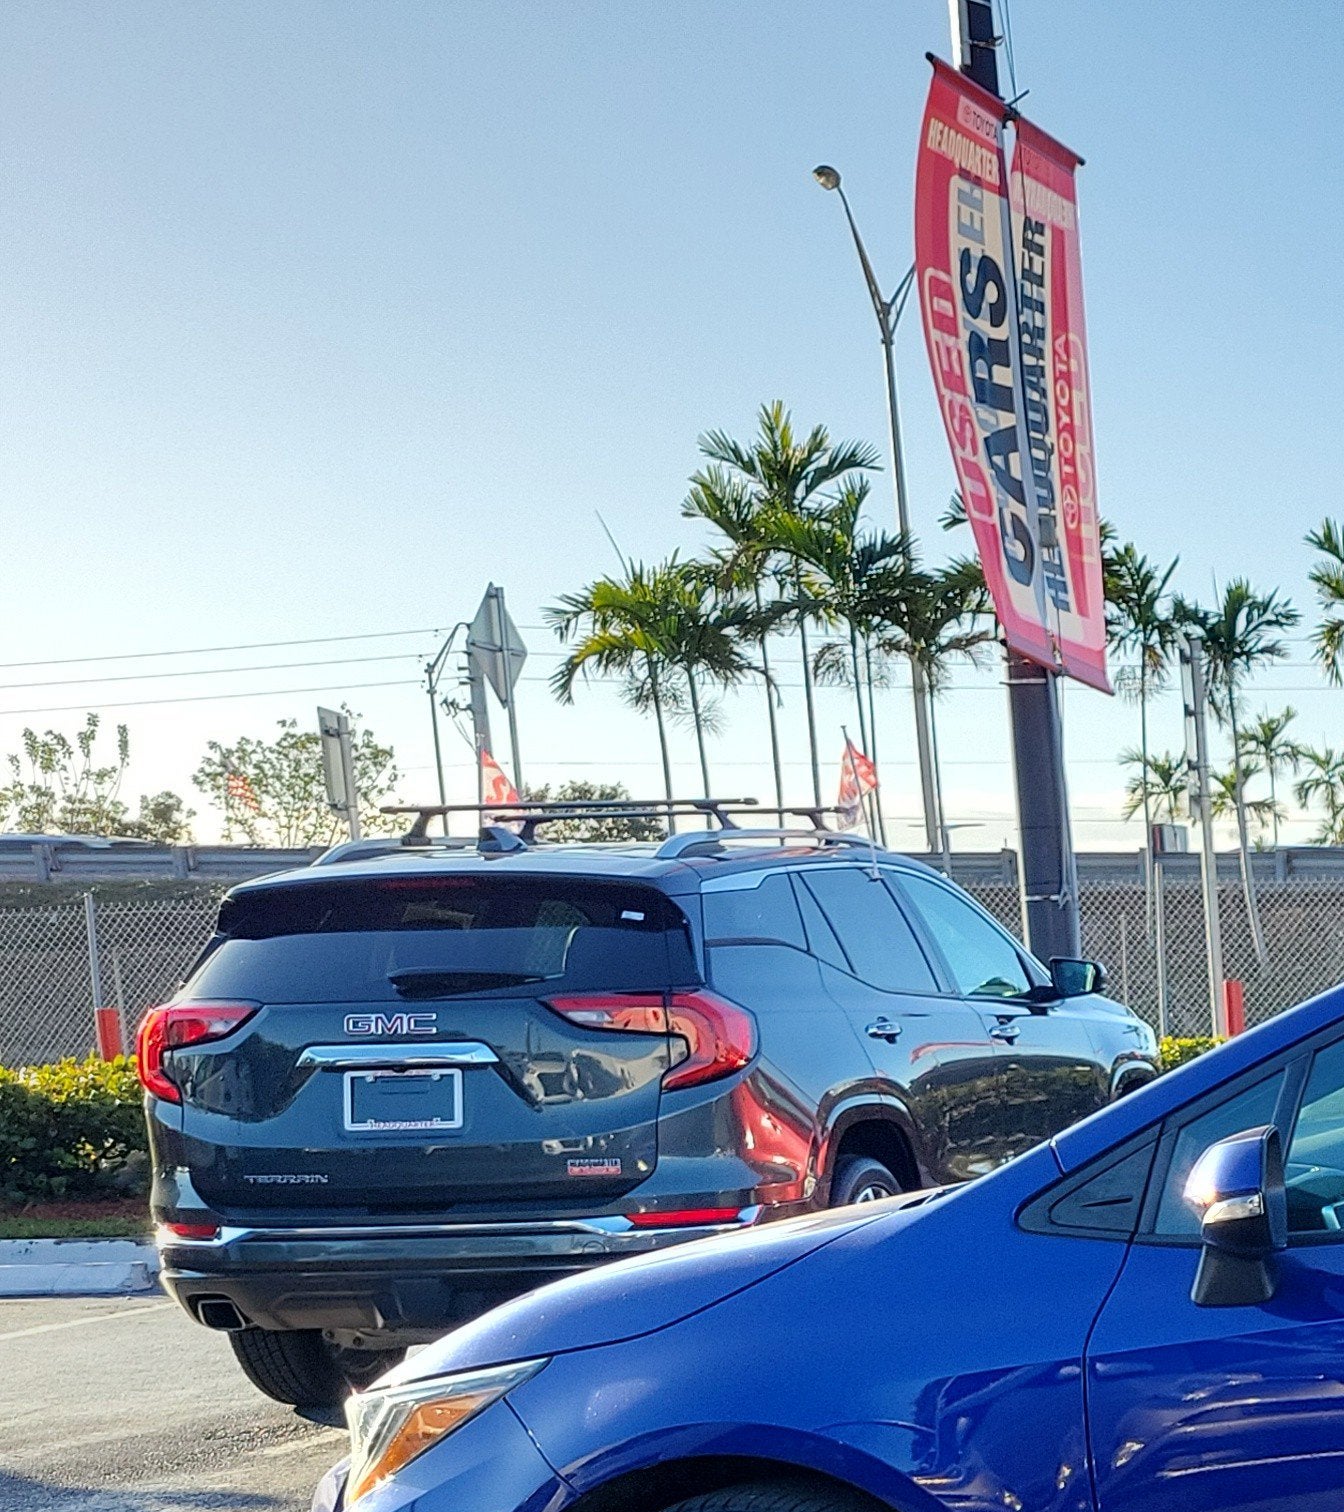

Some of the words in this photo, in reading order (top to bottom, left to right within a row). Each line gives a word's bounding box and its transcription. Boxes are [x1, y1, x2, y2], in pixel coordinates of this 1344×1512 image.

[927, 117, 1000, 187] HEADQUARTER
[971, 110, 998, 140] TOYOTA
[924, 267, 997, 526] USED
[959, 246, 1035, 588] CARS
[1053, 333, 1078, 477] TOYOTA
[343, 1012, 438, 1036] GMC
[242, 1174, 329, 1185] TERRAIN
